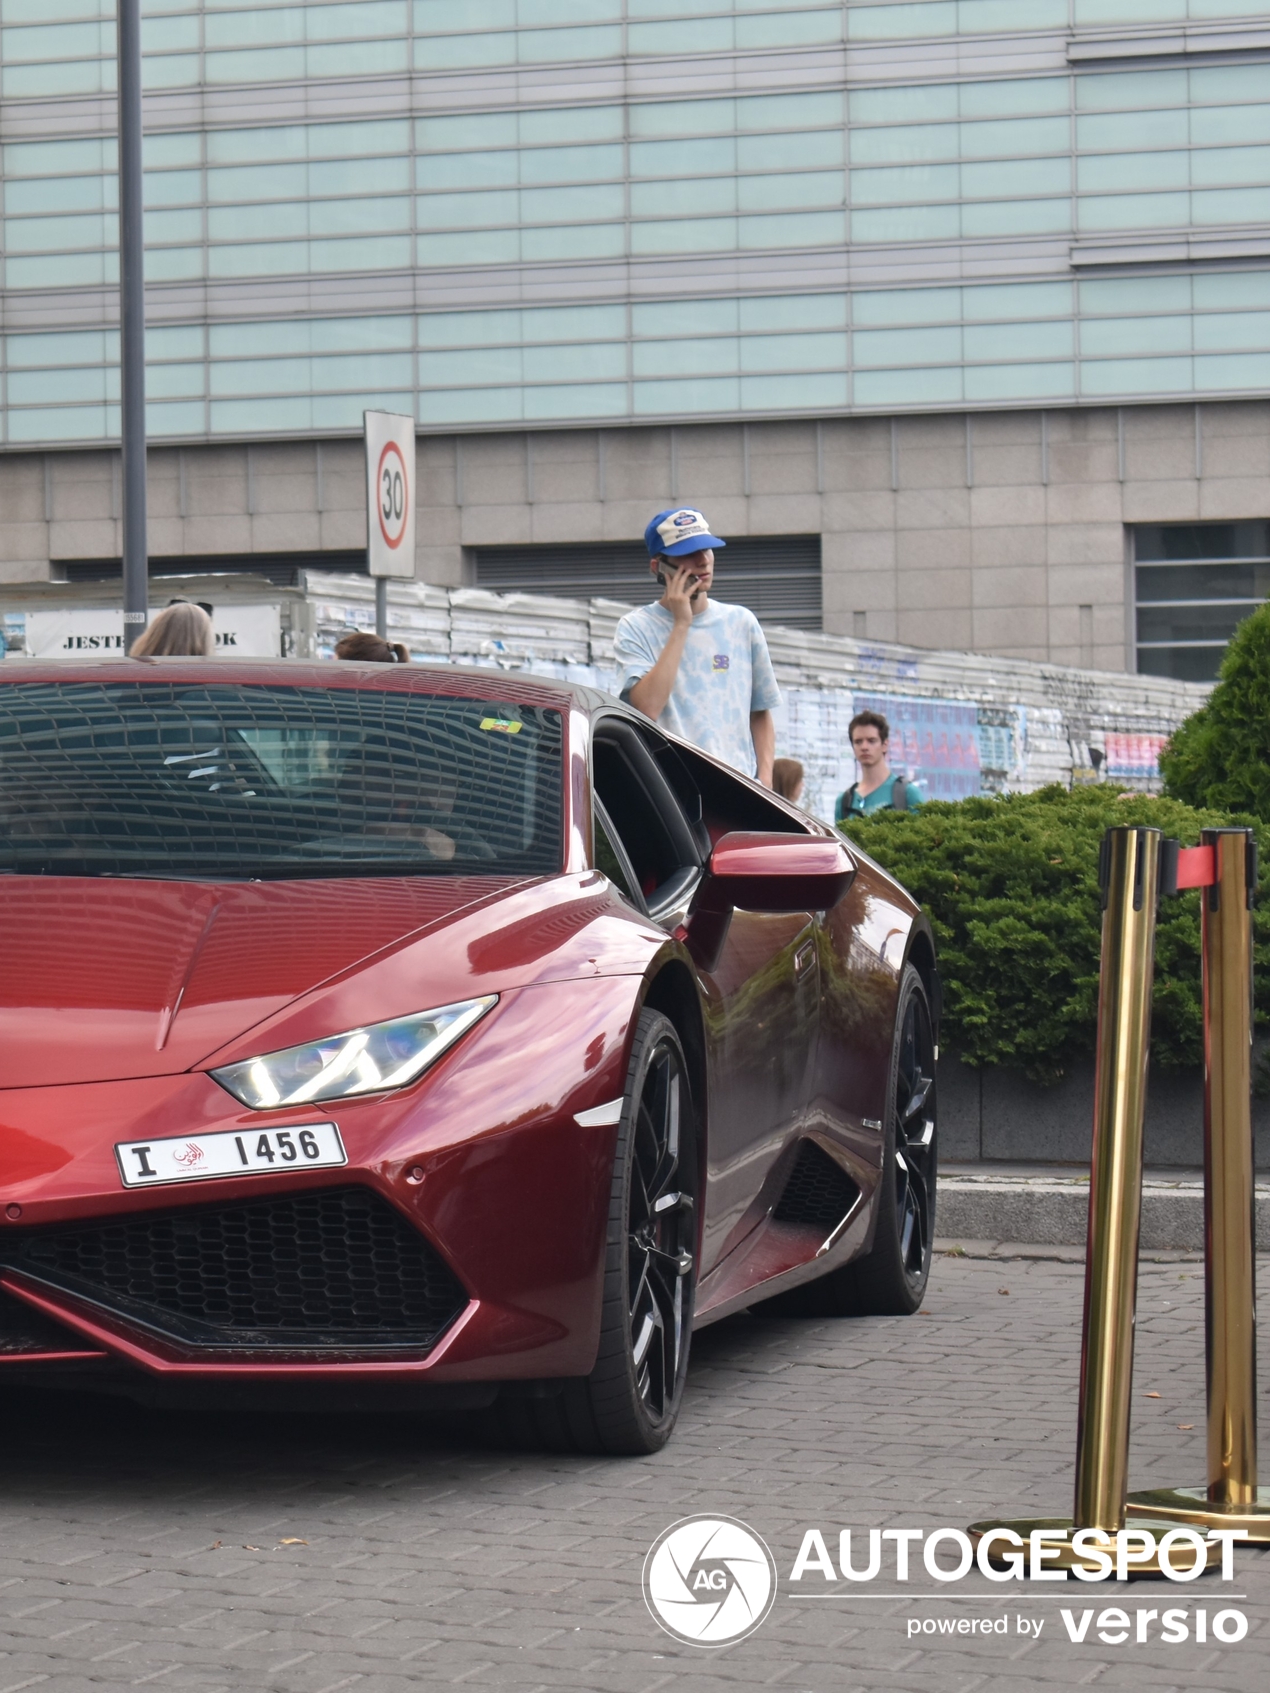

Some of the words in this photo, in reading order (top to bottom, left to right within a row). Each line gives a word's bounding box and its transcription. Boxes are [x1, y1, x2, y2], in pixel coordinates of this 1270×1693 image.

[383, 468, 403, 521] 30
[63, 636, 125, 649] JESTE
[132, 1146, 157, 1176] I
[235, 1130, 320, 1165] 1456
